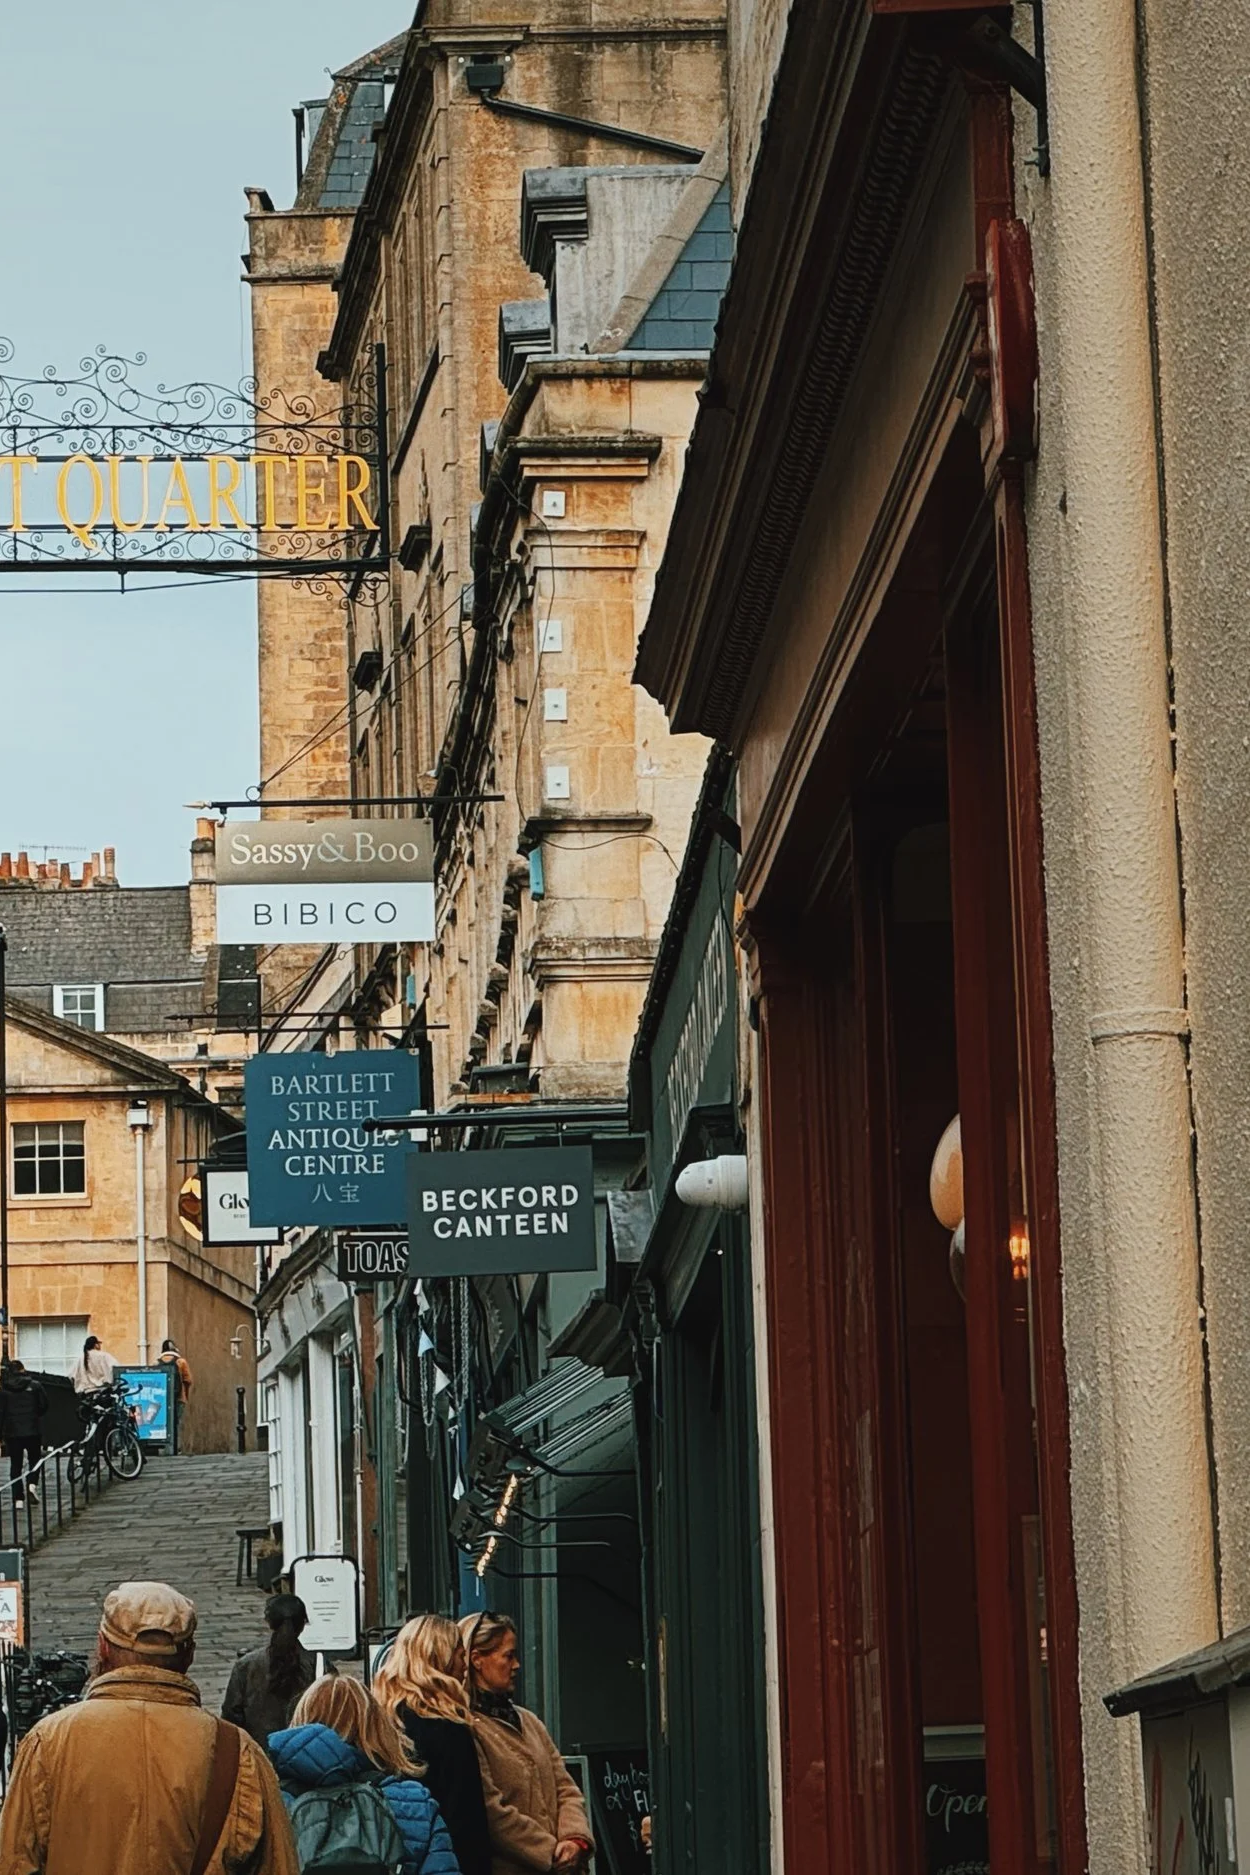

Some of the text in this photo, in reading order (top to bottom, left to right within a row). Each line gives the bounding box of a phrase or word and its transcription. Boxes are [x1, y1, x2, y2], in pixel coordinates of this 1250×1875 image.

[56, 455, 380, 551] QUARTER
[254, 901, 397, 926] BIBICO
[271, 1072, 395, 1096] BARTLETT
[288, 1100, 379, 1122] STREET
[284, 1153, 385, 1176] CENTRE
[219, 1193, 250, 1209] Glo
[422, 1184, 579, 1213] BECKFORD
[433, 1212, 568, 1239] CANTEEN
[343, 1240, 409, 1273] TOAS
